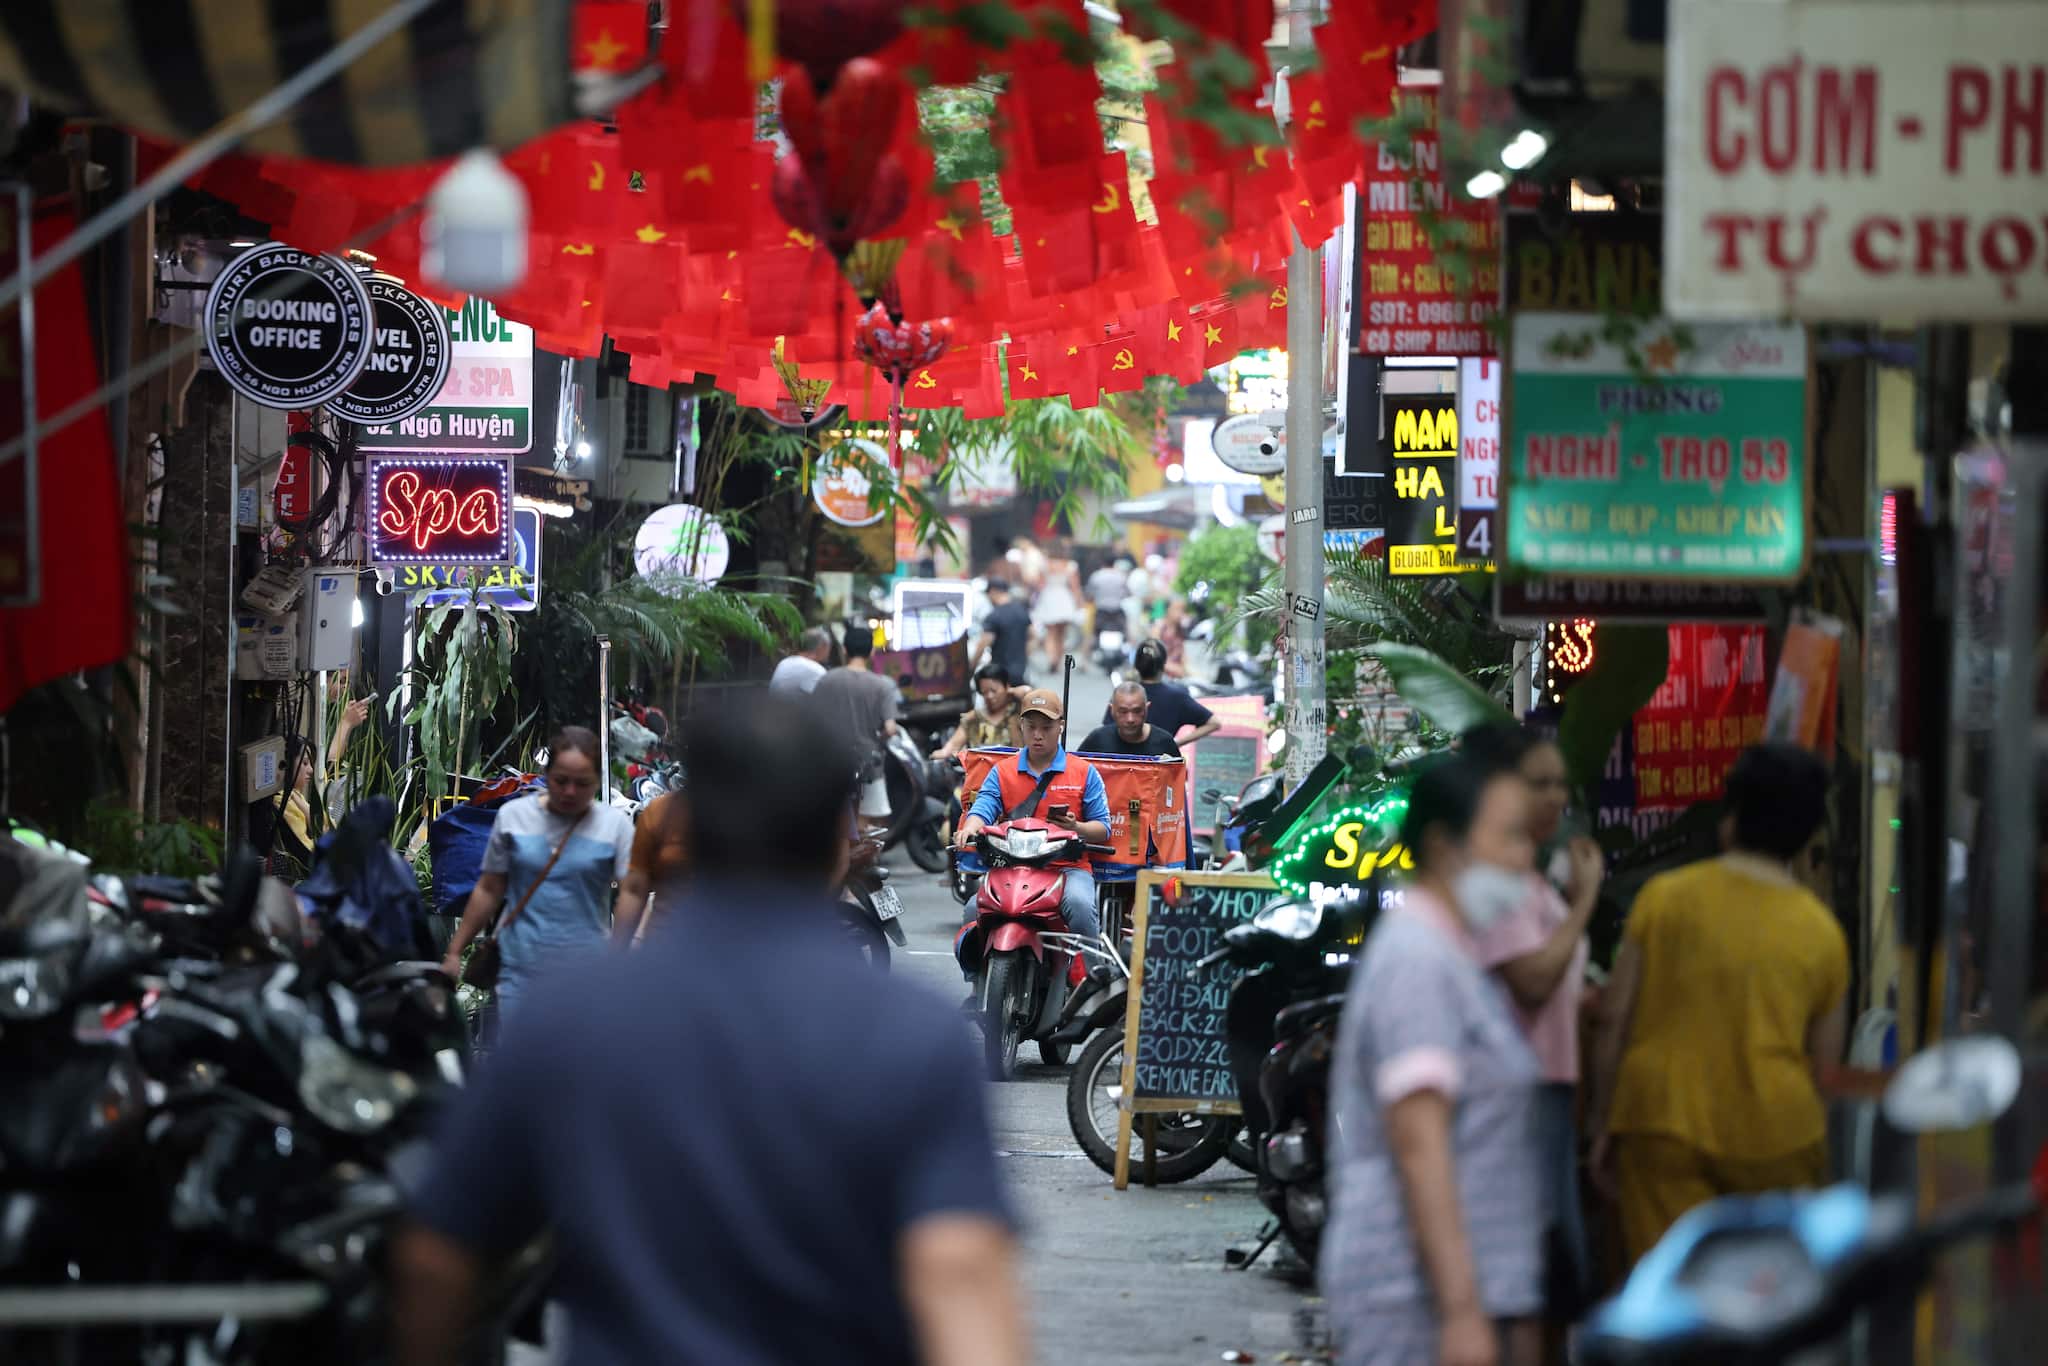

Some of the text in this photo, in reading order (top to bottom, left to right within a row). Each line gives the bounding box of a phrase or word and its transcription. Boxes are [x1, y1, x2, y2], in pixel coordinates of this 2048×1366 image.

[1851, 212, 2048, 302] CHỌ
[217, 253, 362, 343] LUXURY BACKPACKERS
[242, 299, 337, 324] BOOKING
[250, 326, 322, 350] OFFICE
[372, 285, 437, 368] CKPACKERS
[374, 328, 412, 350] VEL
[261, 383, 291, 397] NGO
[294, 373, 337, 396] HUYEN
[469, 366, 515, 397] SPA
[345, 403, 373, 415] NGO
[375, 394, 415, 416] HUYEN
[399, 412, 442, 439] Ngõ
[449, 412, 515, 442] Huyện
[1393, 408, 1458, 451] MAM
[1741, 437, 1790, 484] 53
[381, 471, 500, 550] Spa
[1394, 551, 1434, 568] GLOBAL
[1134, 1063, 1201, 1096] REMOVE
